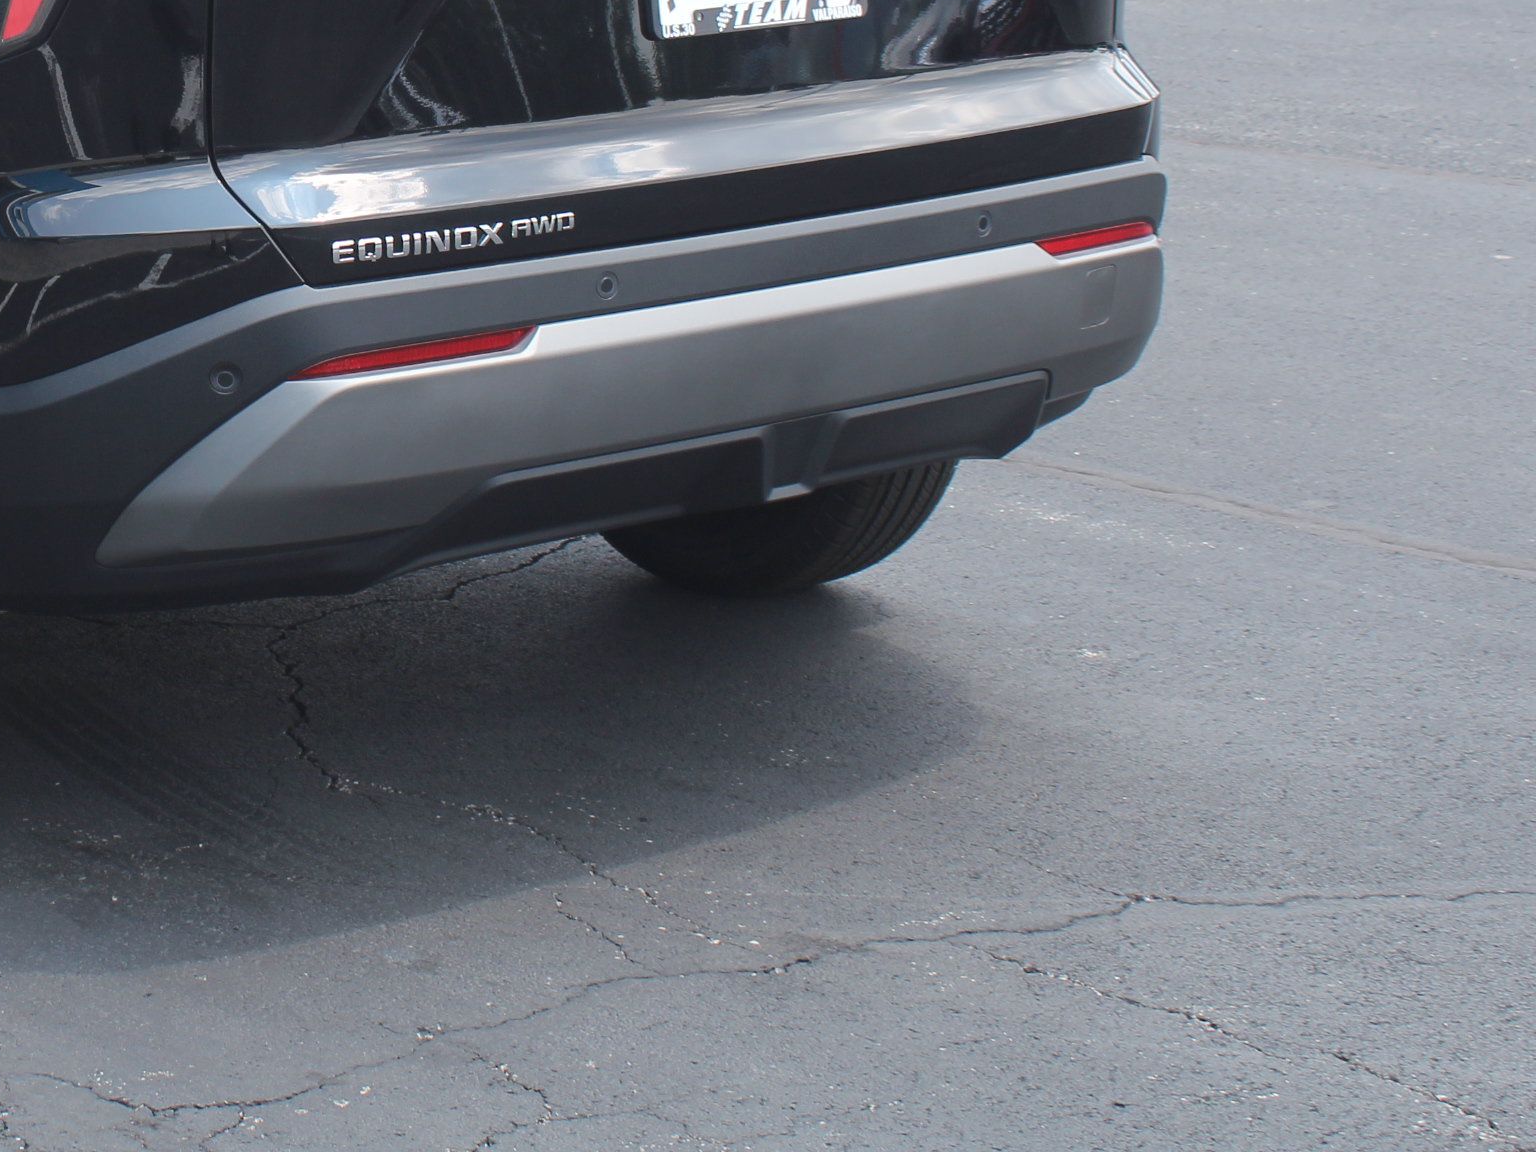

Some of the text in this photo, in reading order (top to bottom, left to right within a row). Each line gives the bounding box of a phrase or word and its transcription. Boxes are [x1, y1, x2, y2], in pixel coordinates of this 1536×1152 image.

[812, 4, 863, 22] VALPARAISO
[331, 211, 576, 264] EQUINOX AWD
